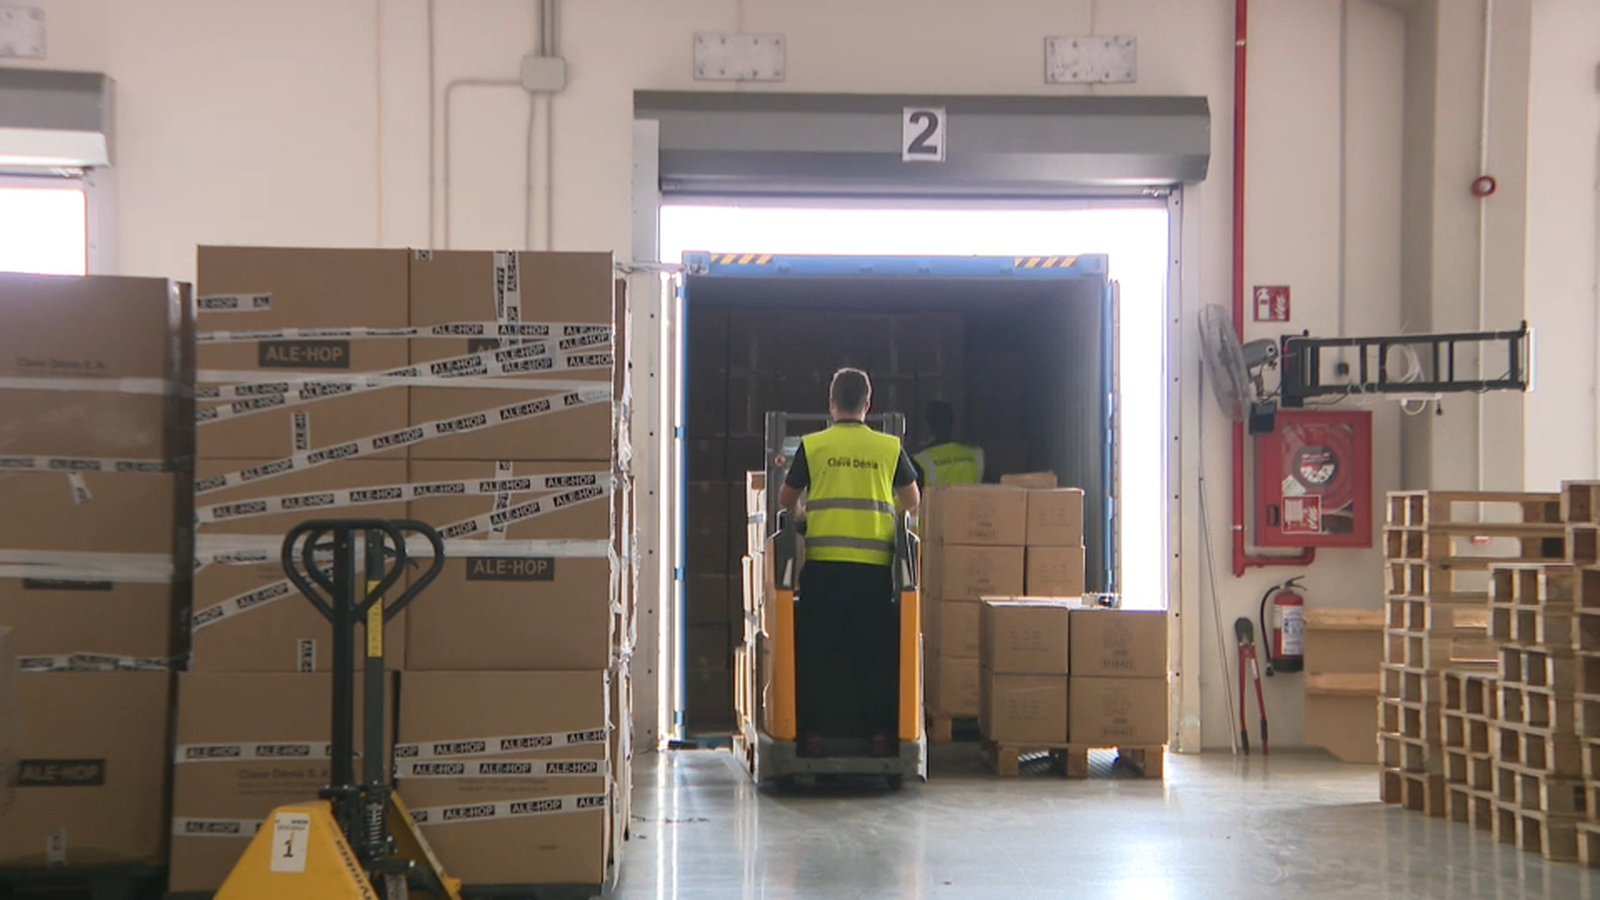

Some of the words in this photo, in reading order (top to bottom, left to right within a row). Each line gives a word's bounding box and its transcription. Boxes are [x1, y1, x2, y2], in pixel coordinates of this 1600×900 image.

[908, 112, 938, 154] 2
[482, 480, 530, 492] ALE-HOP
[547, 475, 595, 488] ALE-HOP
[435, 742, 485, 755] ALE-HOP
[503, 737, 551, 750] ALE-HOP
[415, 764, 463, 774] ALE-HOP
[481, 764, 530, 774] ALE-HOP
[548, 763, 597, 773] ALE-HOP
[445, 805, 494, 819] ALE-HOP
[512, 800, 561, 813] ALE-HOP
